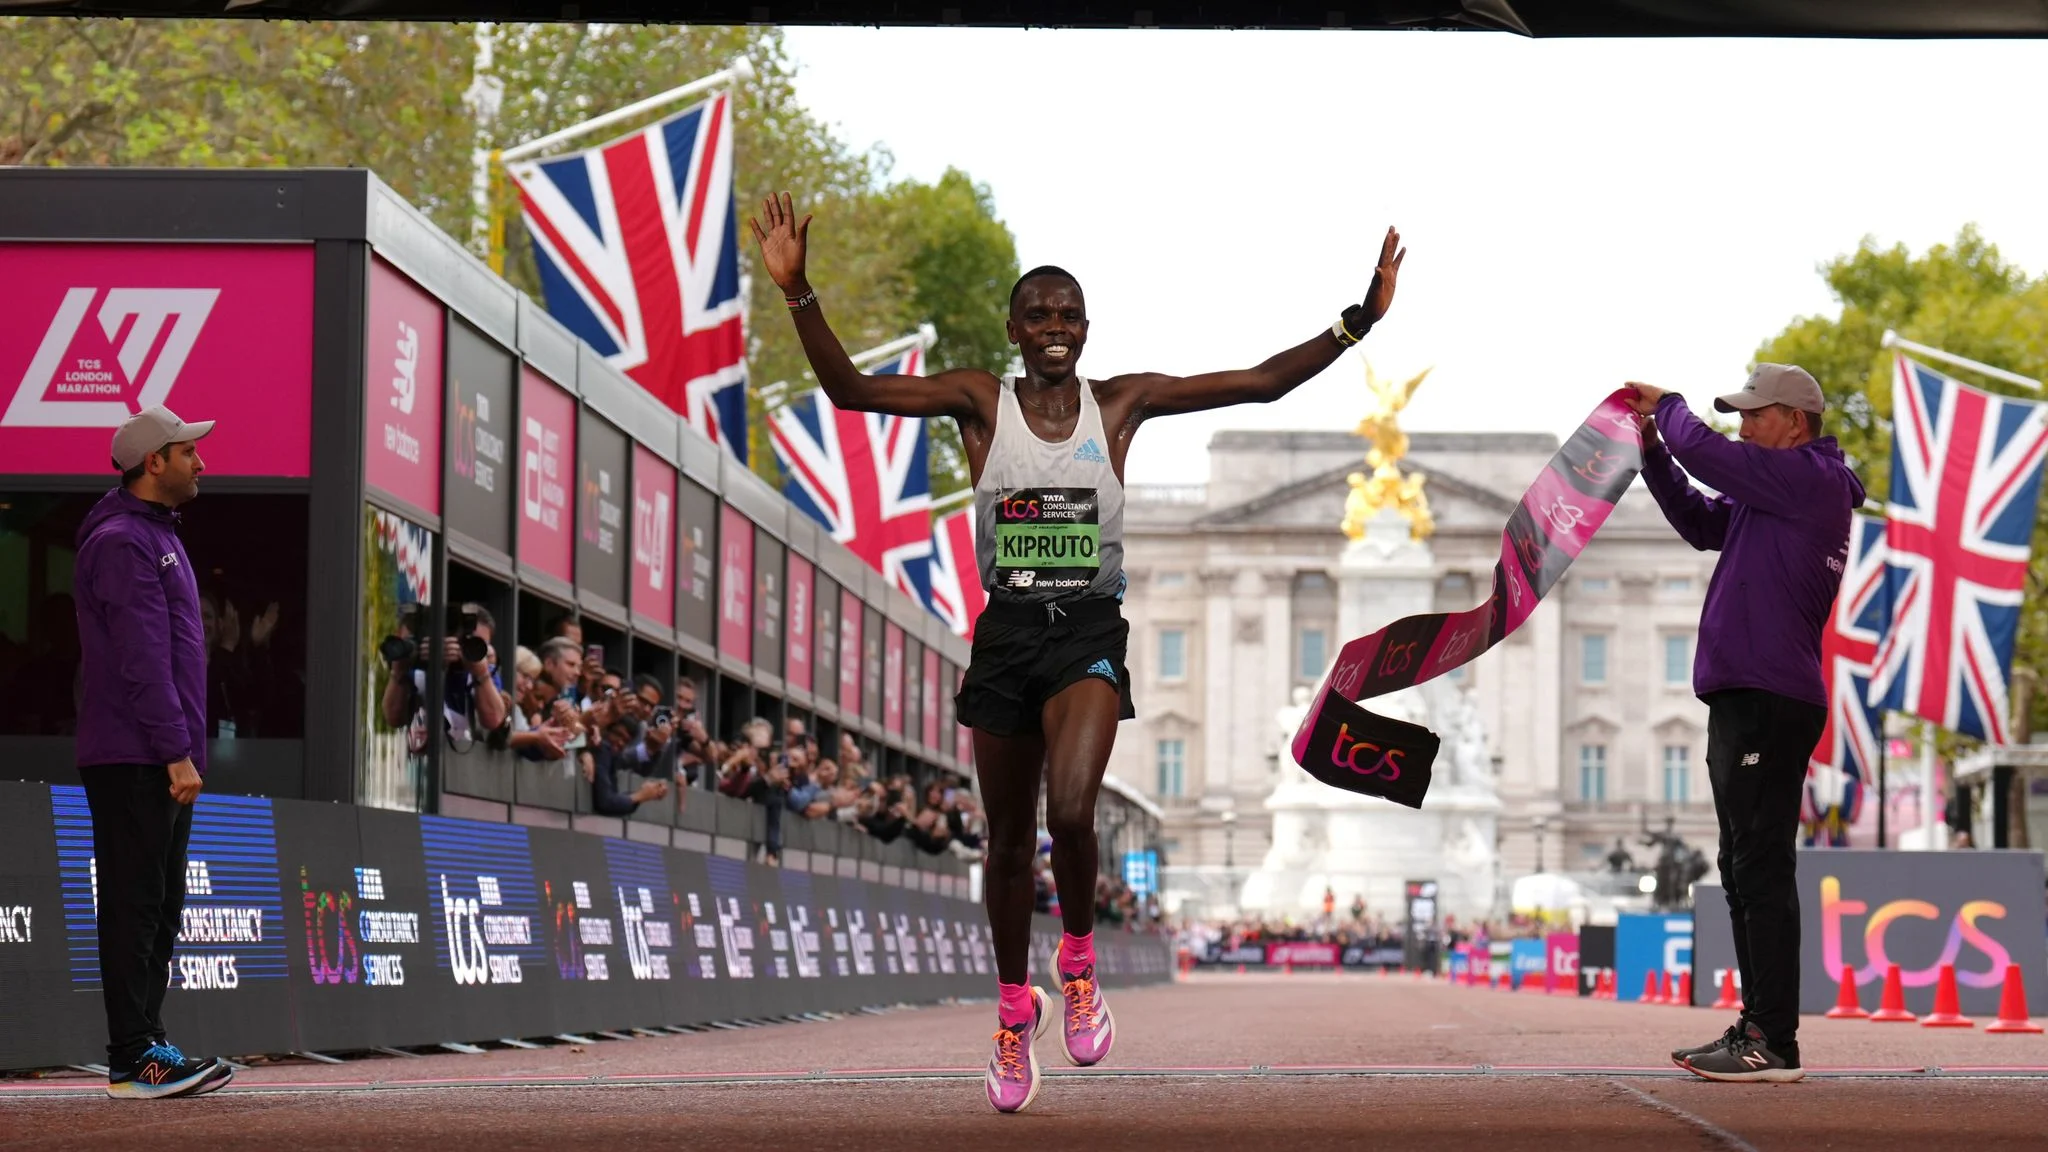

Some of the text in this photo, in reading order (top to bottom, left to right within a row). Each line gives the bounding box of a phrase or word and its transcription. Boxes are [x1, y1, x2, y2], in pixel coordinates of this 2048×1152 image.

[77, 359, 102, 370] TCS
[65, 371, 113, 382] LONDON
[56, 383, 121, 394] MARATHON
[1073, 452, 1106, 464] adidas
[1003, 495, 1040, 518] tcs
[1042, 503, 1093, 511] CONSULTANCY
[1540, 496, 1584, 534] tcs
[1003, 535, 1094, 558] KIPRUTO
[1036, 579, 1054, 587] new
[1378, 640, 1418, 678] tcs
[1331, 722, 1405, 781] tcs
[440, 873, 488, 985] tcs
[1819, 876, 2012, 987] tcs
[179, 954, 239, 990] SERVICES
[363, 954, 405, 986] SERVICES
